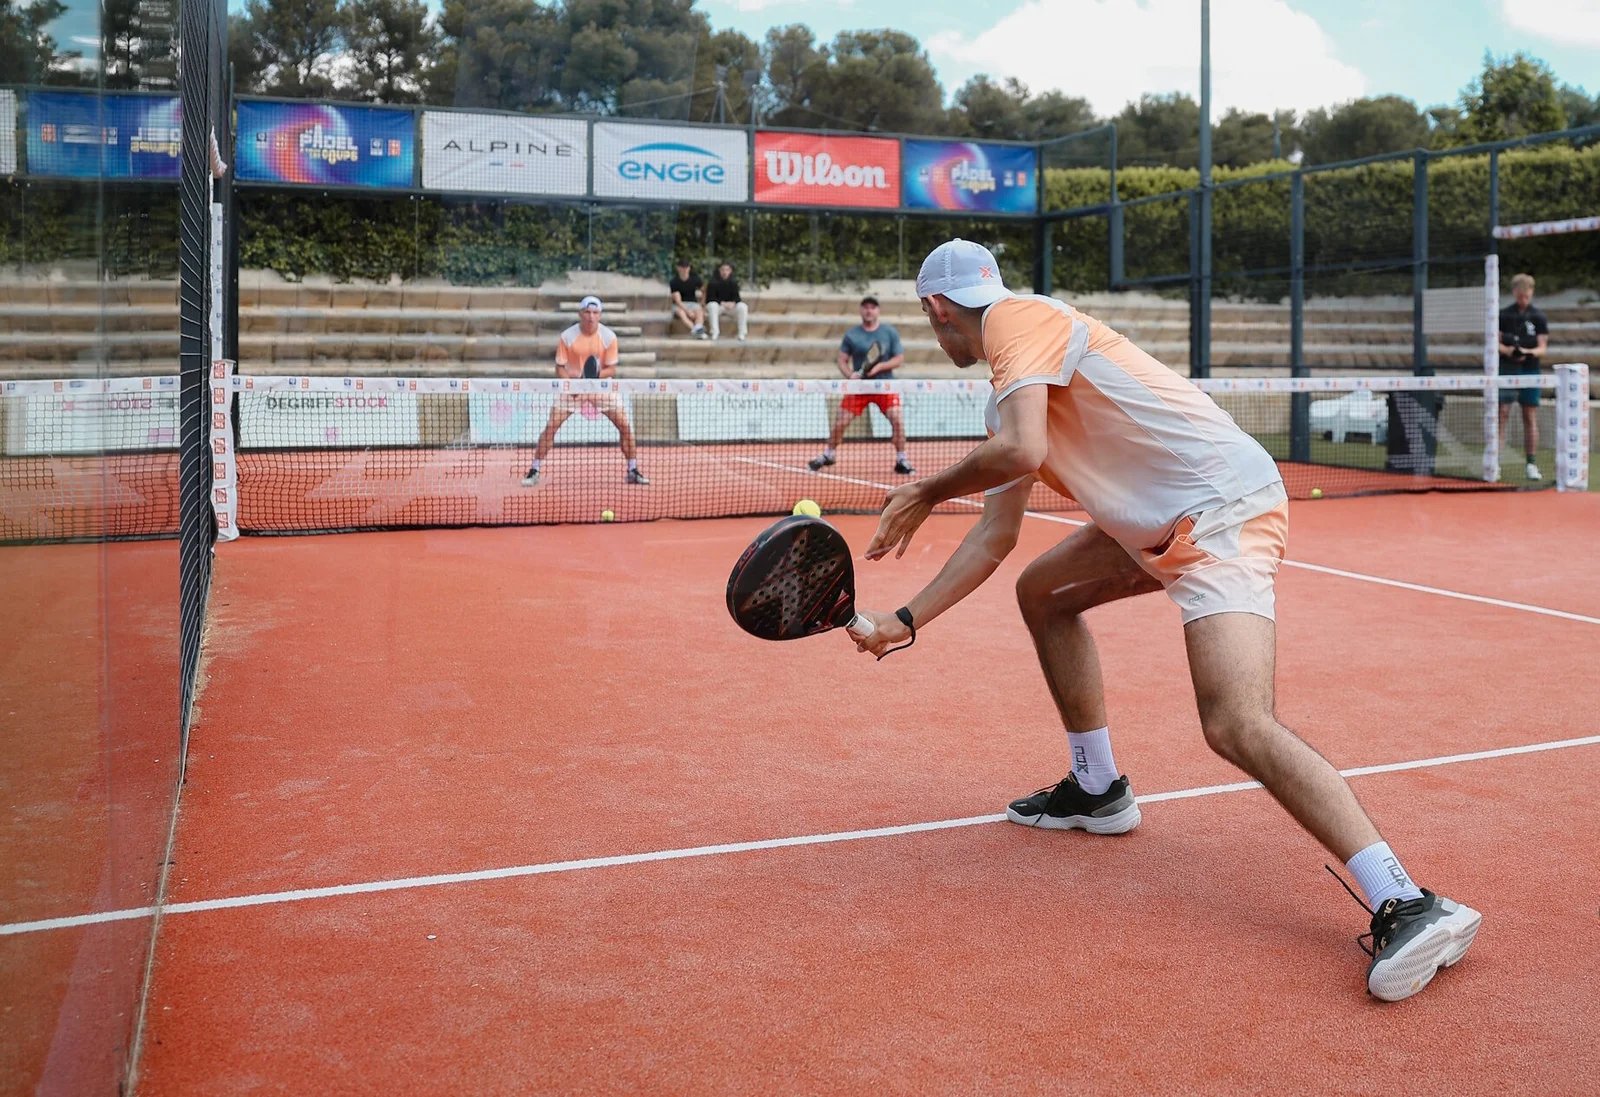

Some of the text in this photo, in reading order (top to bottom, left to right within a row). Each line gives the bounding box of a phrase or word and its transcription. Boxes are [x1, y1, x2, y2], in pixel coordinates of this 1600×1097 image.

[442, 139, 572, 157] ALPINE
[764, 150, 889, 189] Wilson
[267, 396, 388, 409] DEGRIFFSTOCK
